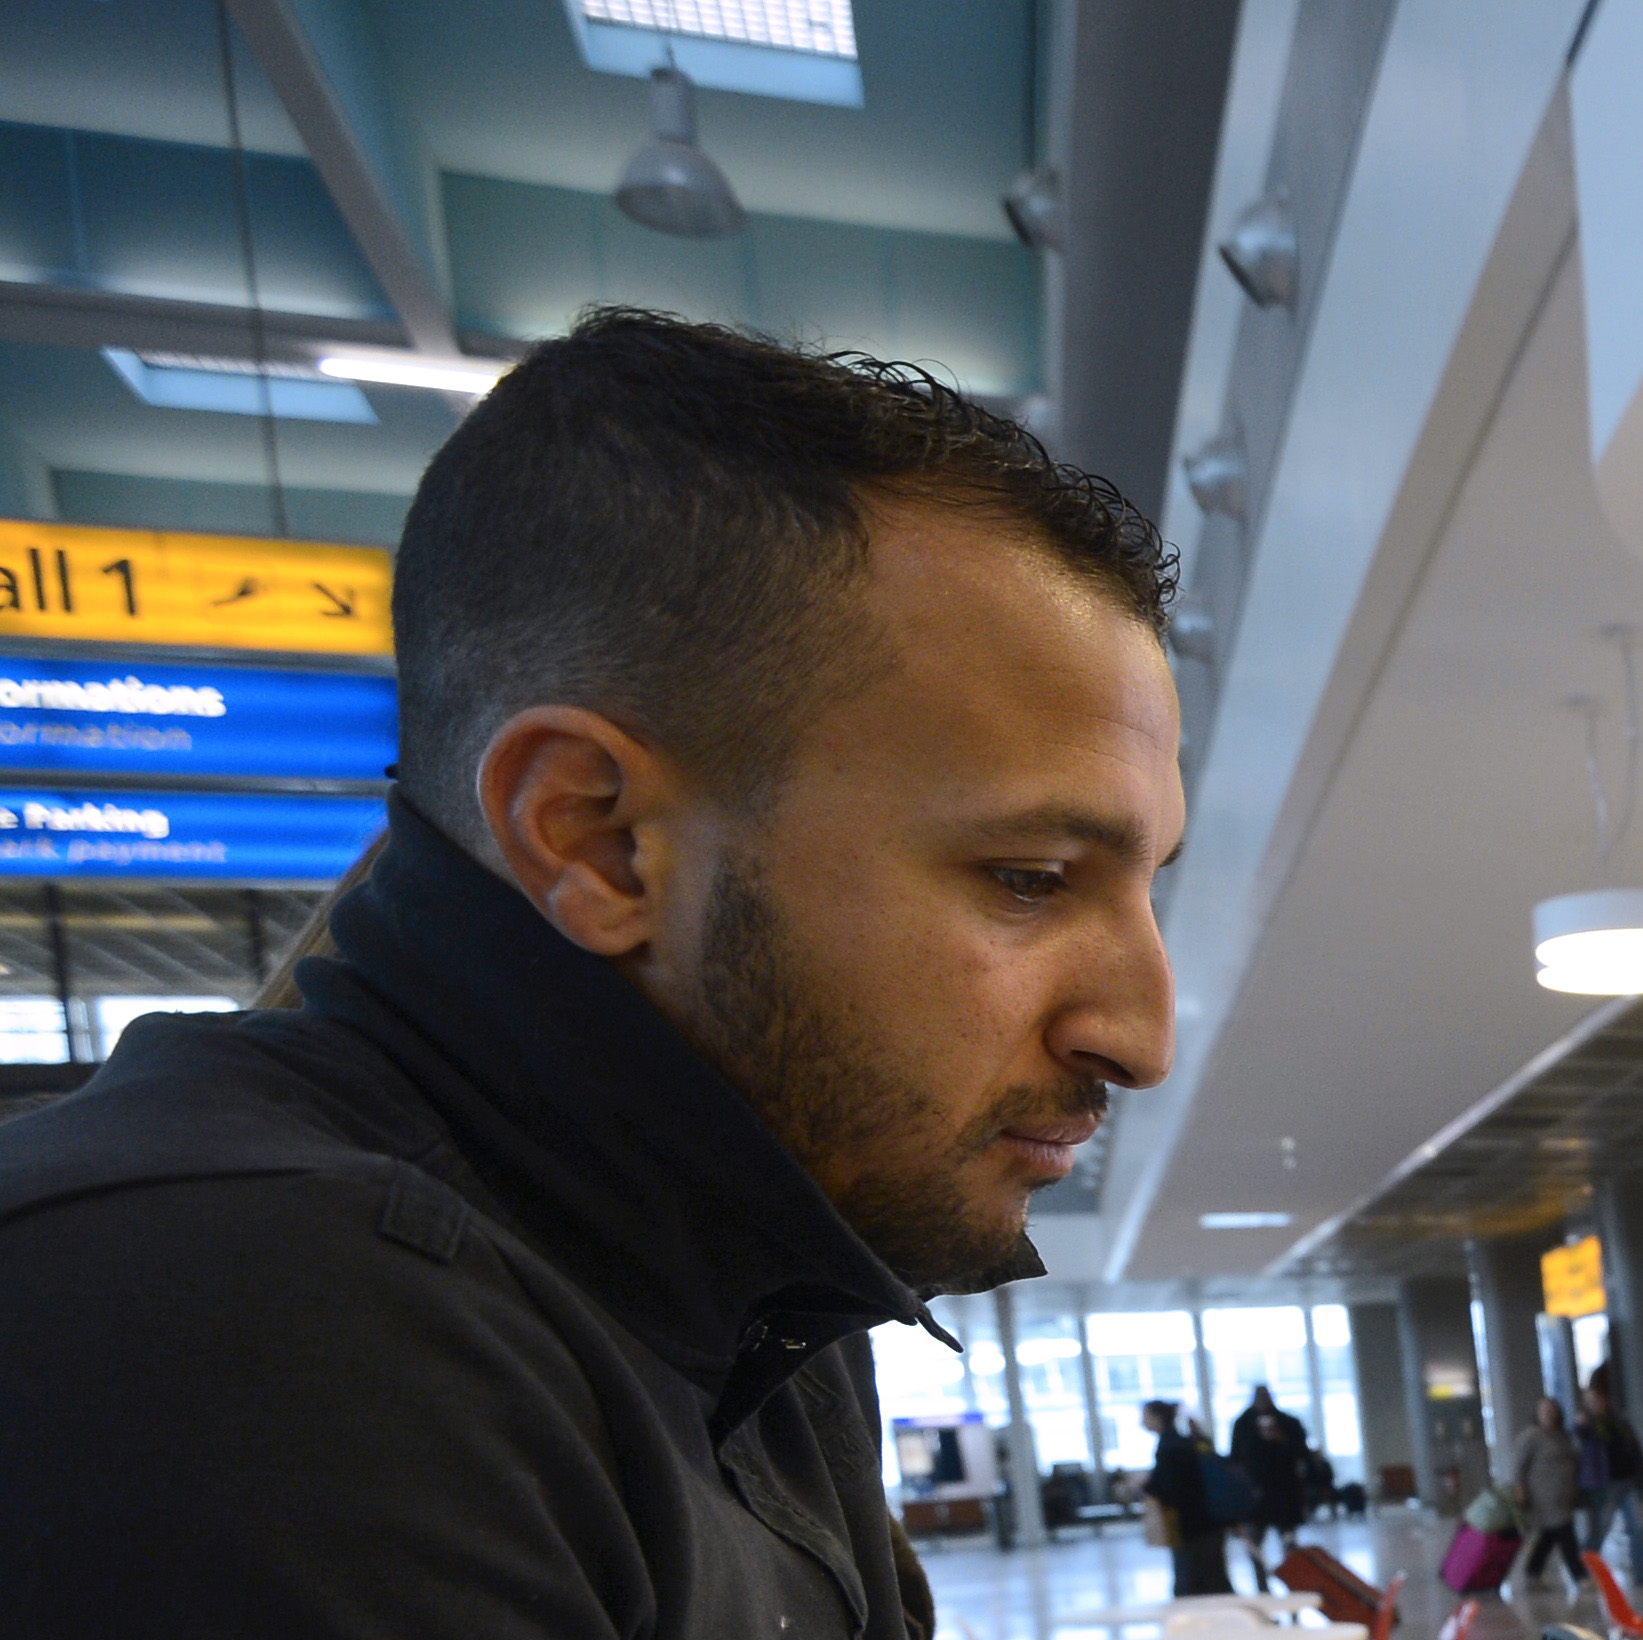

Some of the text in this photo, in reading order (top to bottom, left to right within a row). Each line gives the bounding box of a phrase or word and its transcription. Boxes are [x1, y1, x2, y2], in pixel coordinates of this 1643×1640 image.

[102, 559, 139, 617] 1
[23, 802, 171, 839] Parking
[66, 838, 227, 866] payment
